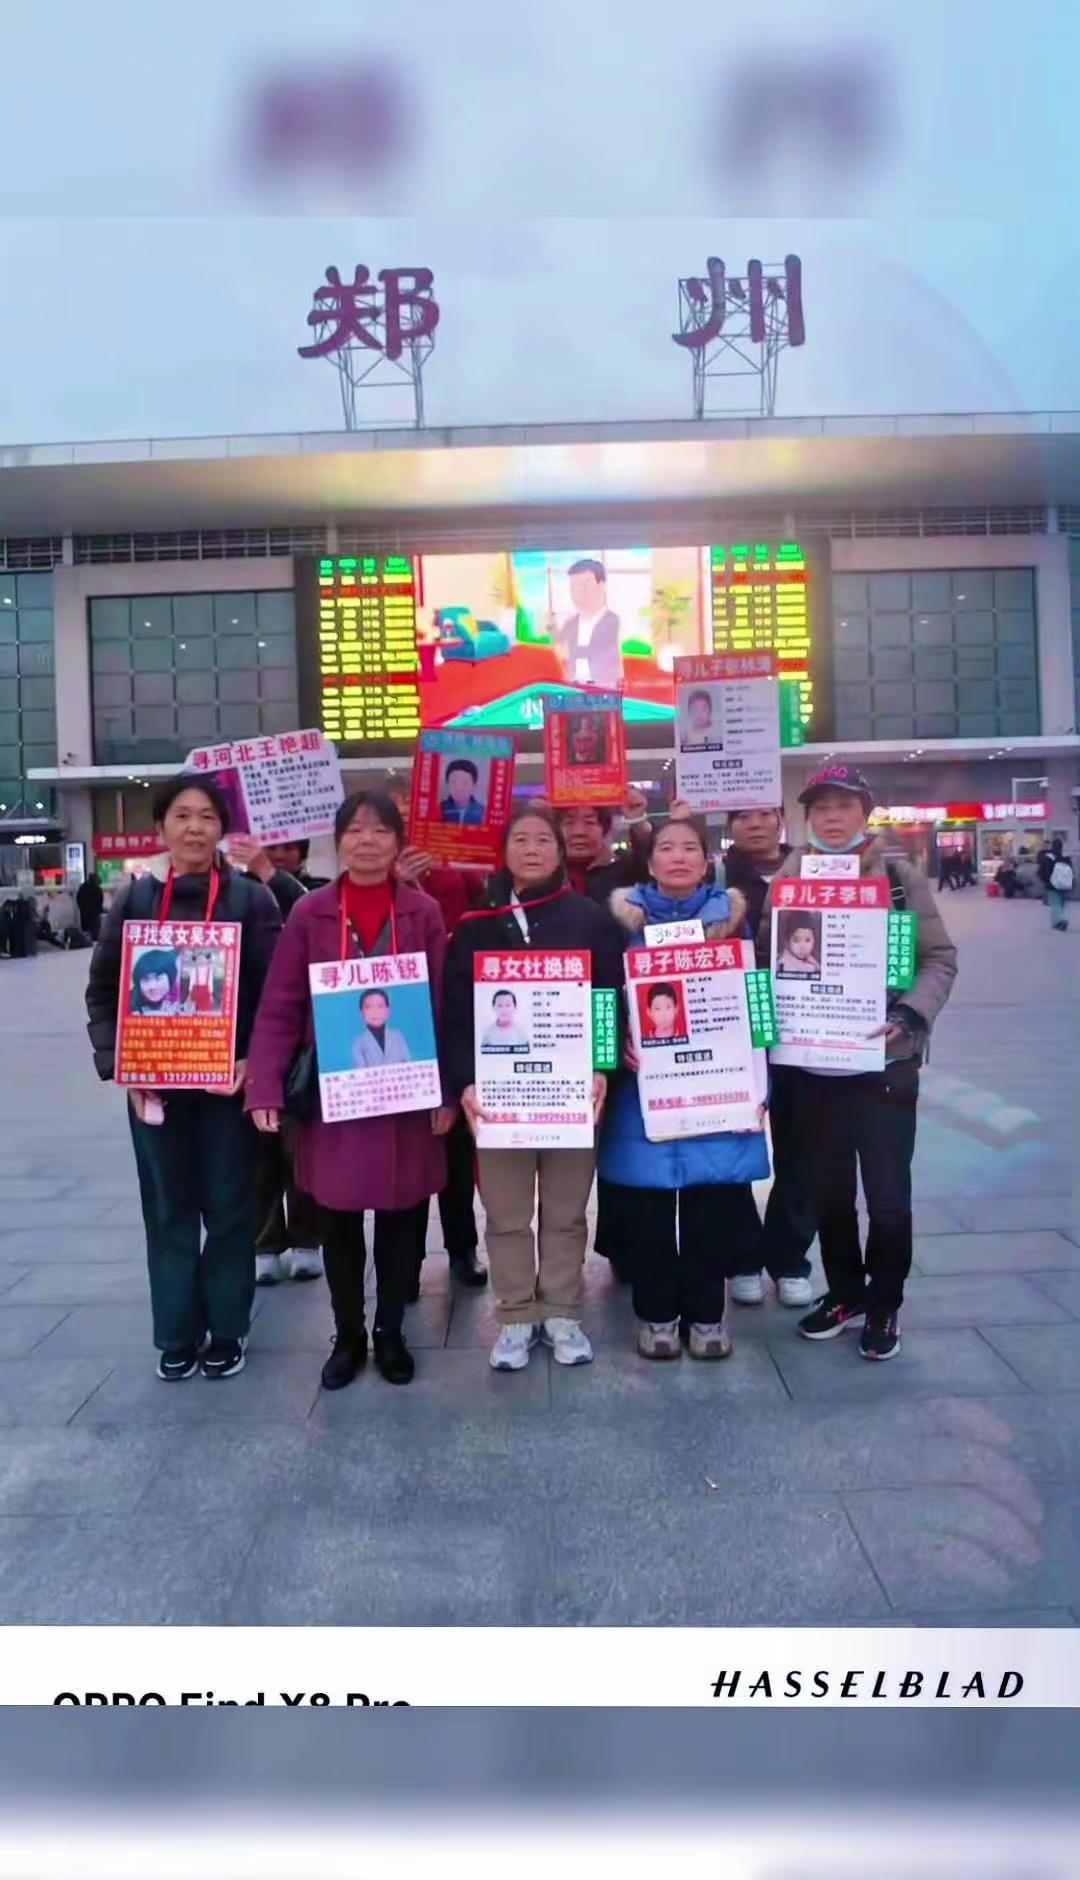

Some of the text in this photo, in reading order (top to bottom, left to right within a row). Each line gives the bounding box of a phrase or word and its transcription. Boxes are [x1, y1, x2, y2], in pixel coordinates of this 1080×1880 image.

[298, 254, 806, 360] 郑 州
[319, 958, 420, 988] 寻儿陈锐
[634, 945, 736, 974] 寻子陈宏亮
